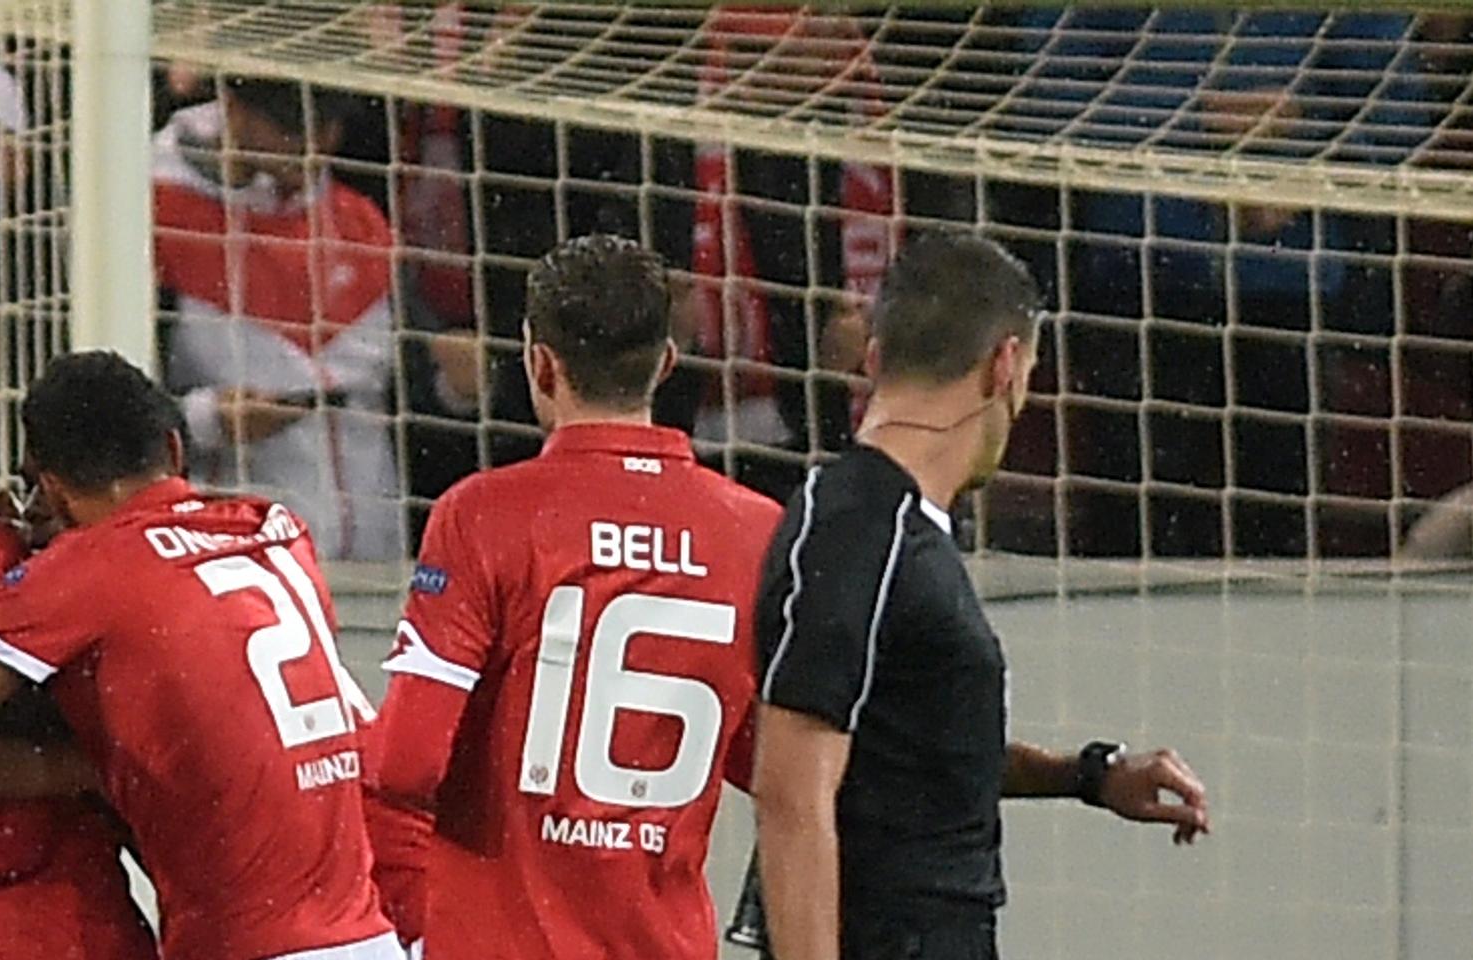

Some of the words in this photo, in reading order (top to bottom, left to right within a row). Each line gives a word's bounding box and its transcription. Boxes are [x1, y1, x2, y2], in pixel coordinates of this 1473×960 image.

[590, 521, 709, 577] BELL
[519, 585, 737, 808] 16
[541, 814, 633, 850] MAINZ
